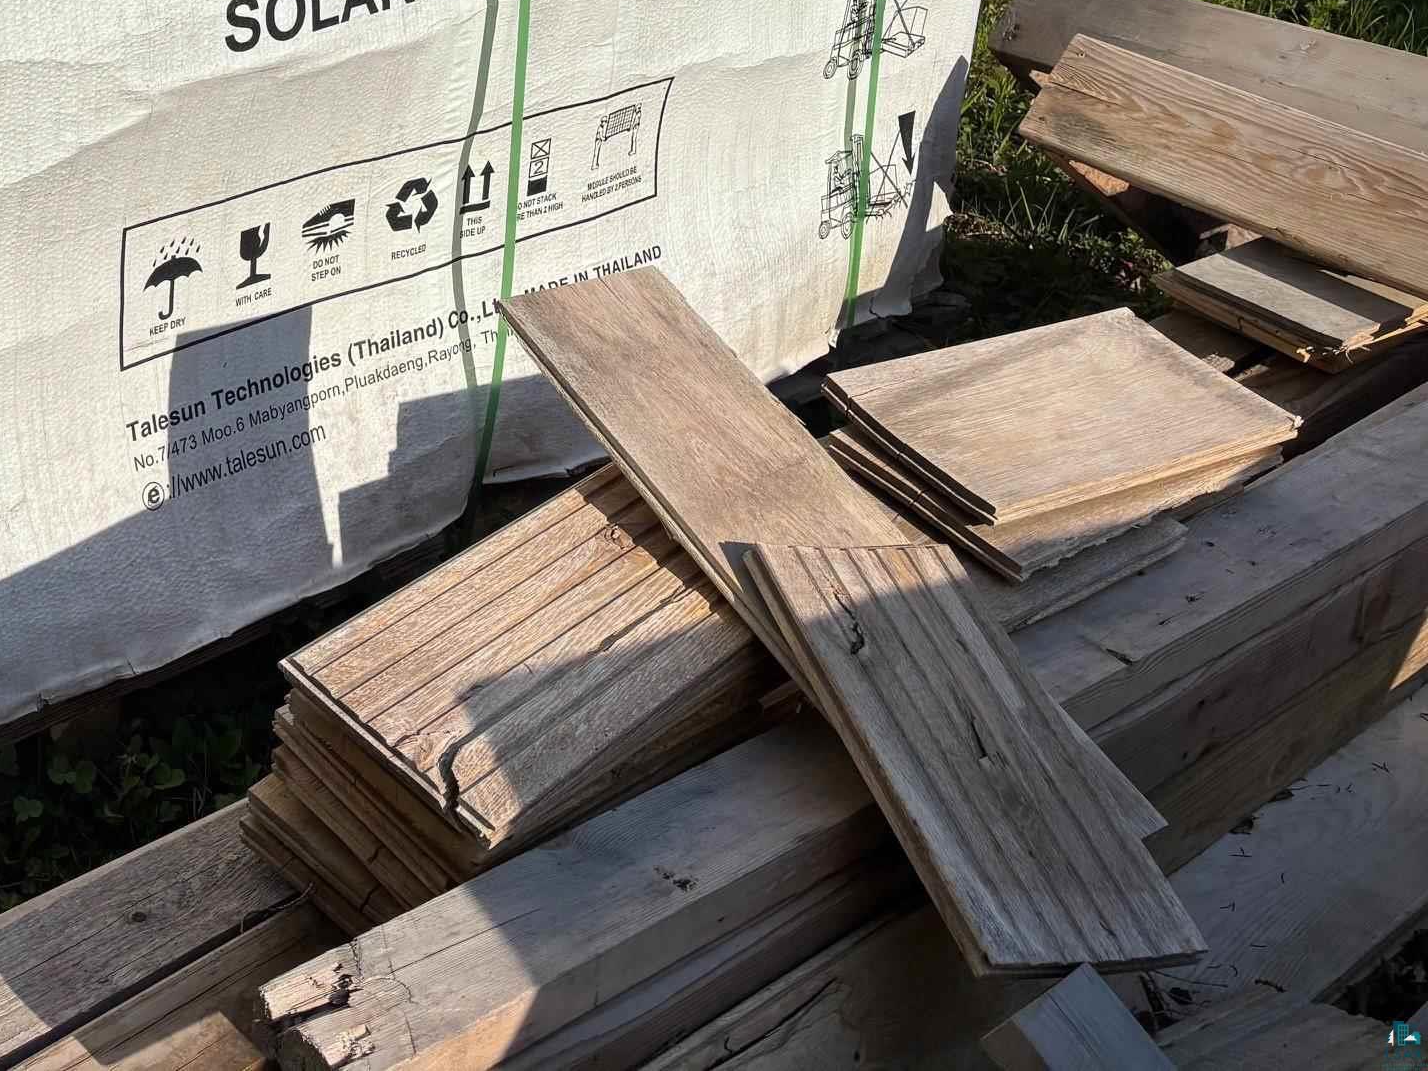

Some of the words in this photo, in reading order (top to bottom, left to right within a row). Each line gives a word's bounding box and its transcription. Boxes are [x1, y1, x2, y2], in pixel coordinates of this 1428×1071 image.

[581, 189, 607, 203] HANDLED
[618, 175, 642, 190] PERSONS
[586, 176, 610, 191] MODULE
[609, 169, 630, 183] SHOULD
[523, 198, 537, 209] NOT
[536, 193, 558, 206] STACK
[525, 207, 543, 219] THAN
[547, 201, 564, 213] HIGH
[466, 216, 483, 227] THIS
[459, 227, 476, 239] SIDE
[476, 225, 486, 235] UP
[390, 243, 427, 261] RECYCLED
[312, 257, 324, 270] DO
[324, 254, 340, 267] NOT
[573, 270, 589, 284] IN
[593, 245, 662, 279] THAILAND
[311, 269, 330, 282] STEP
[330, 265, 342, 278] ON
[235, 294, 253, 307] WITH
[253, 287, 273, 302] CARE
[149, 323, 169, 337] KEEP
[170, 316, 187, 332] DRY
[125, 400, 207, 442] Talesun
[210, 352, 342, 410] Technologies
[347, 315, 445, 367] (Thailand)
[448, 297, 500, 329] Co.,Lt
[133, 435, 198, 472] No.7/473
[201, 416, 245, 445] Moo.6
